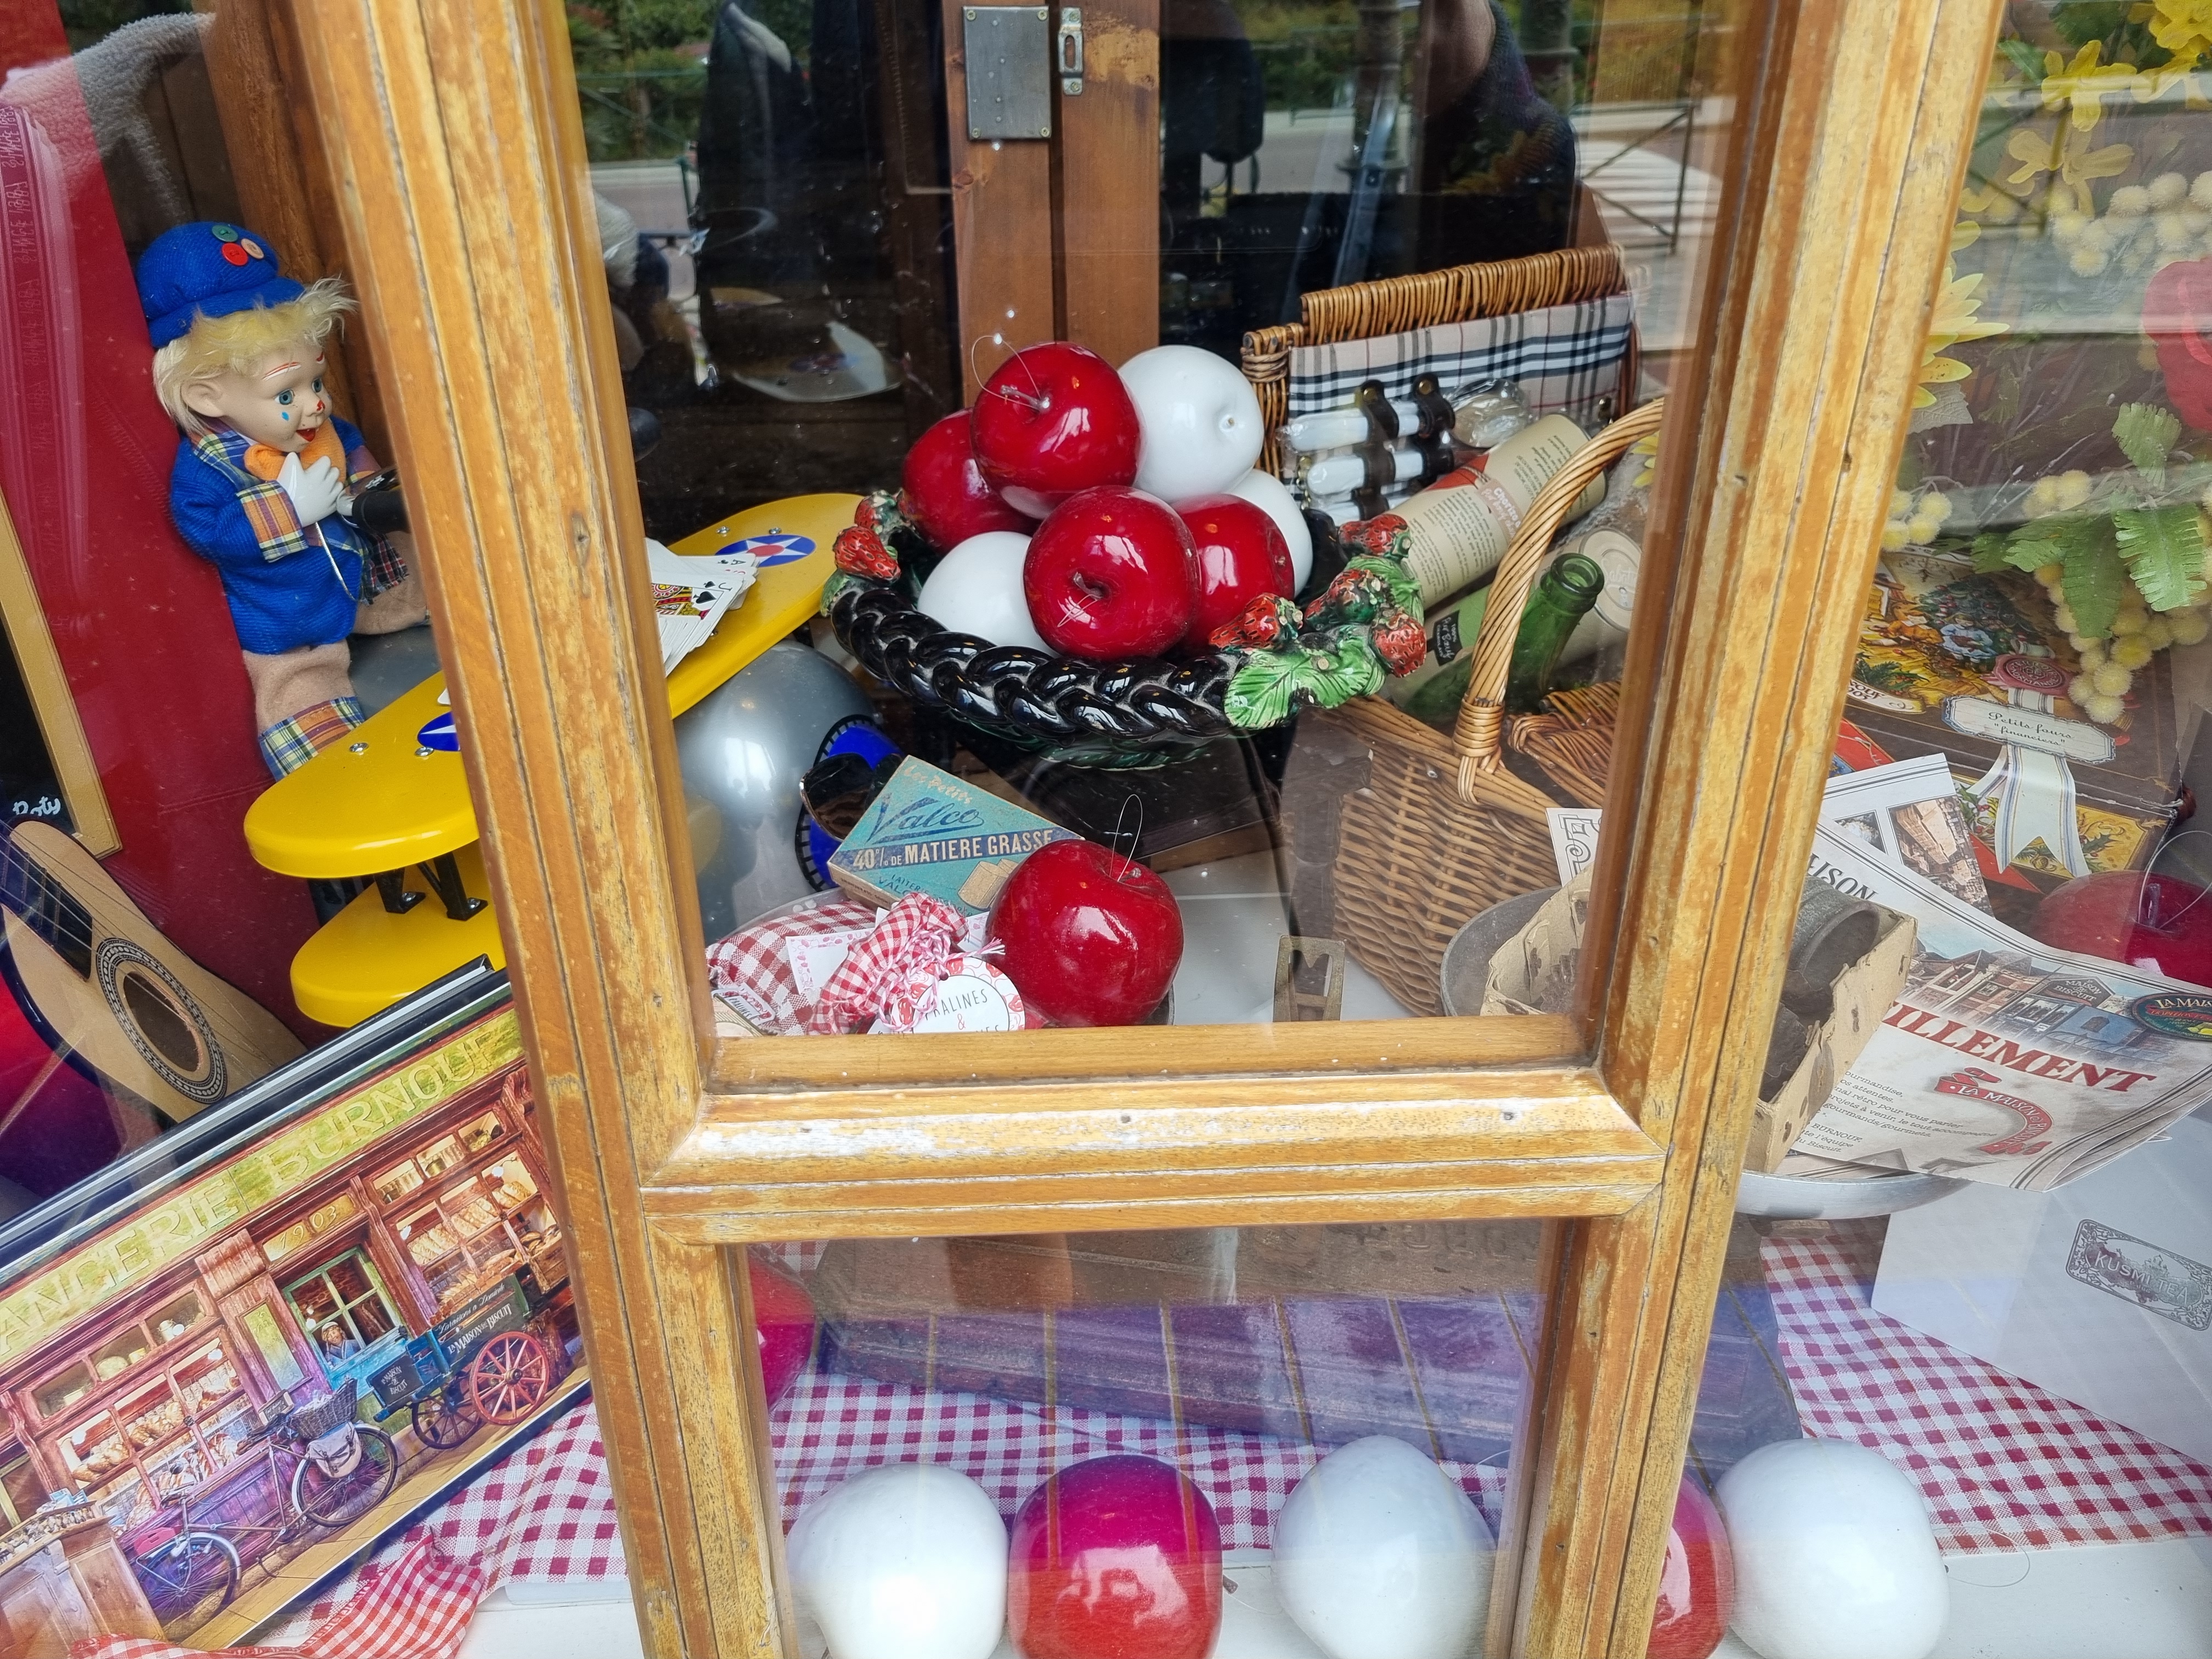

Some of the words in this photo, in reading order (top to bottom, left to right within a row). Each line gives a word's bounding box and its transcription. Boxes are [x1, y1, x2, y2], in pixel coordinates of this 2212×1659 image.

[1988, 712, 2034, 729] Petits
[2036, 724, 2075, 739] fours
[866, 792, 985, 844] Valco
[891, 855, 902, 866] DE
[905, 837, 983, 864] MATIERE
[988, 830, 1053, 855] GRASSE
[2053, 985, 2097, 1002] BISCUIT
[2065, 980, 2102, 994] MAISON
[2154, 998, 2176, 1009] LA
[1881, 1001, 2158, 1093] ILLEMENT
[257, 1029, 498, 1188] BURNOUF
[1852, 1083, 1894, 1104] attentes.
[1852, 1093, 1878, 1107] rétro
[1877, 1103, 1904, 1116] pour
[1905, 1111, 1930, 1122] vous
[1929, 1119, 1963, 1130] parler
[1957, 1085, 1979, 1096] LA
[1980, 1091, 2040, 1116] MAISON
[1910, 1121, 1933, 1131] tout
[279, 1204, 338, 1251] 1903
[2094, 1250, 2152, 1285] KUSMI
[2157, 1278, 2188, 1306] TEA
[454, 1324, 483, 1354] MAISON
[486, 1303, 512, 1330] BISCUIT
